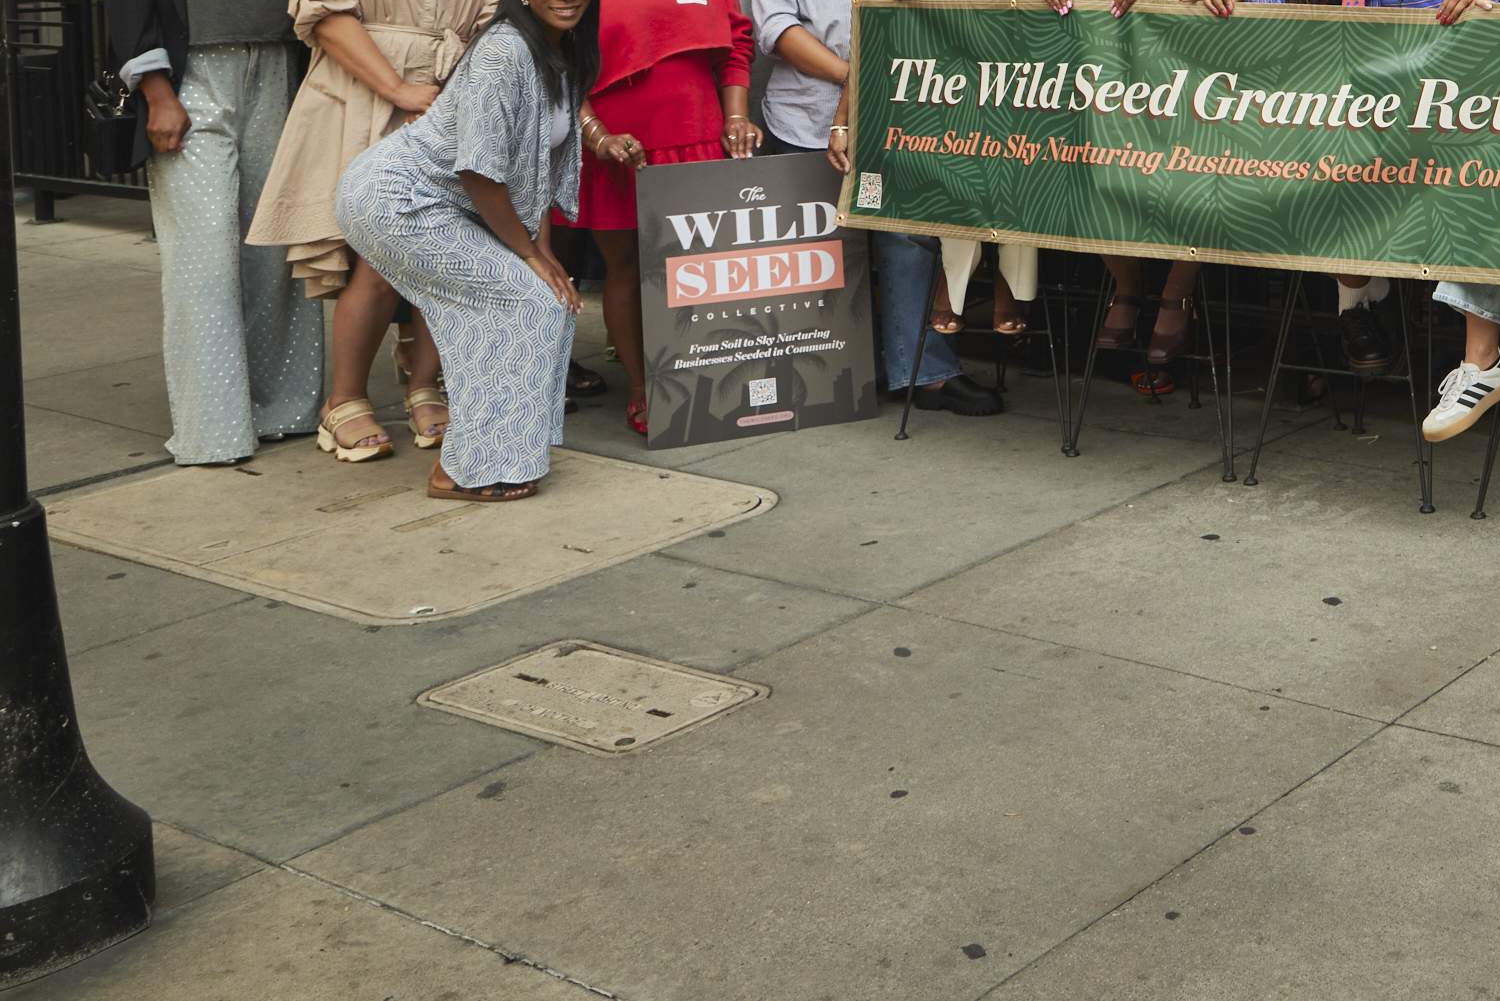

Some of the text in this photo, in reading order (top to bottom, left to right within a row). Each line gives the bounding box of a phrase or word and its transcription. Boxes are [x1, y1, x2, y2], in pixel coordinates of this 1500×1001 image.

[889, 58, 966, 106] The
[977, 62, 1070, 110] Wild
[1068, 63, 1188, 118] Seed
[1193, 71, 1402, 128] Grantee
[884, 127, 937, 155] From
[938, 130, 981, 156] Soil
[982, 134, 1001, 158] to
[1002, 135, 1041, 166] Sky
[1041, 137, 1164, 175] Nurturing
[1165, 146, 1311, 181] Businesses
[1313, 155, 1418, 185] Seeded
[1424, 159, 1452, 187] in
[739, 185, 766, 203] The
[666, 201, 838, 250] WILD
[675, 249, 836, 300] SEED
[691, 299, 825, 322] COLLECTIVE
[674, 339, 846, 370] Businesses Seeded in Community
[688, 328, 830, 356] From Soil to Sky Nurturing
[739, 412, 792, 425] THEWILDSEED.ORG
